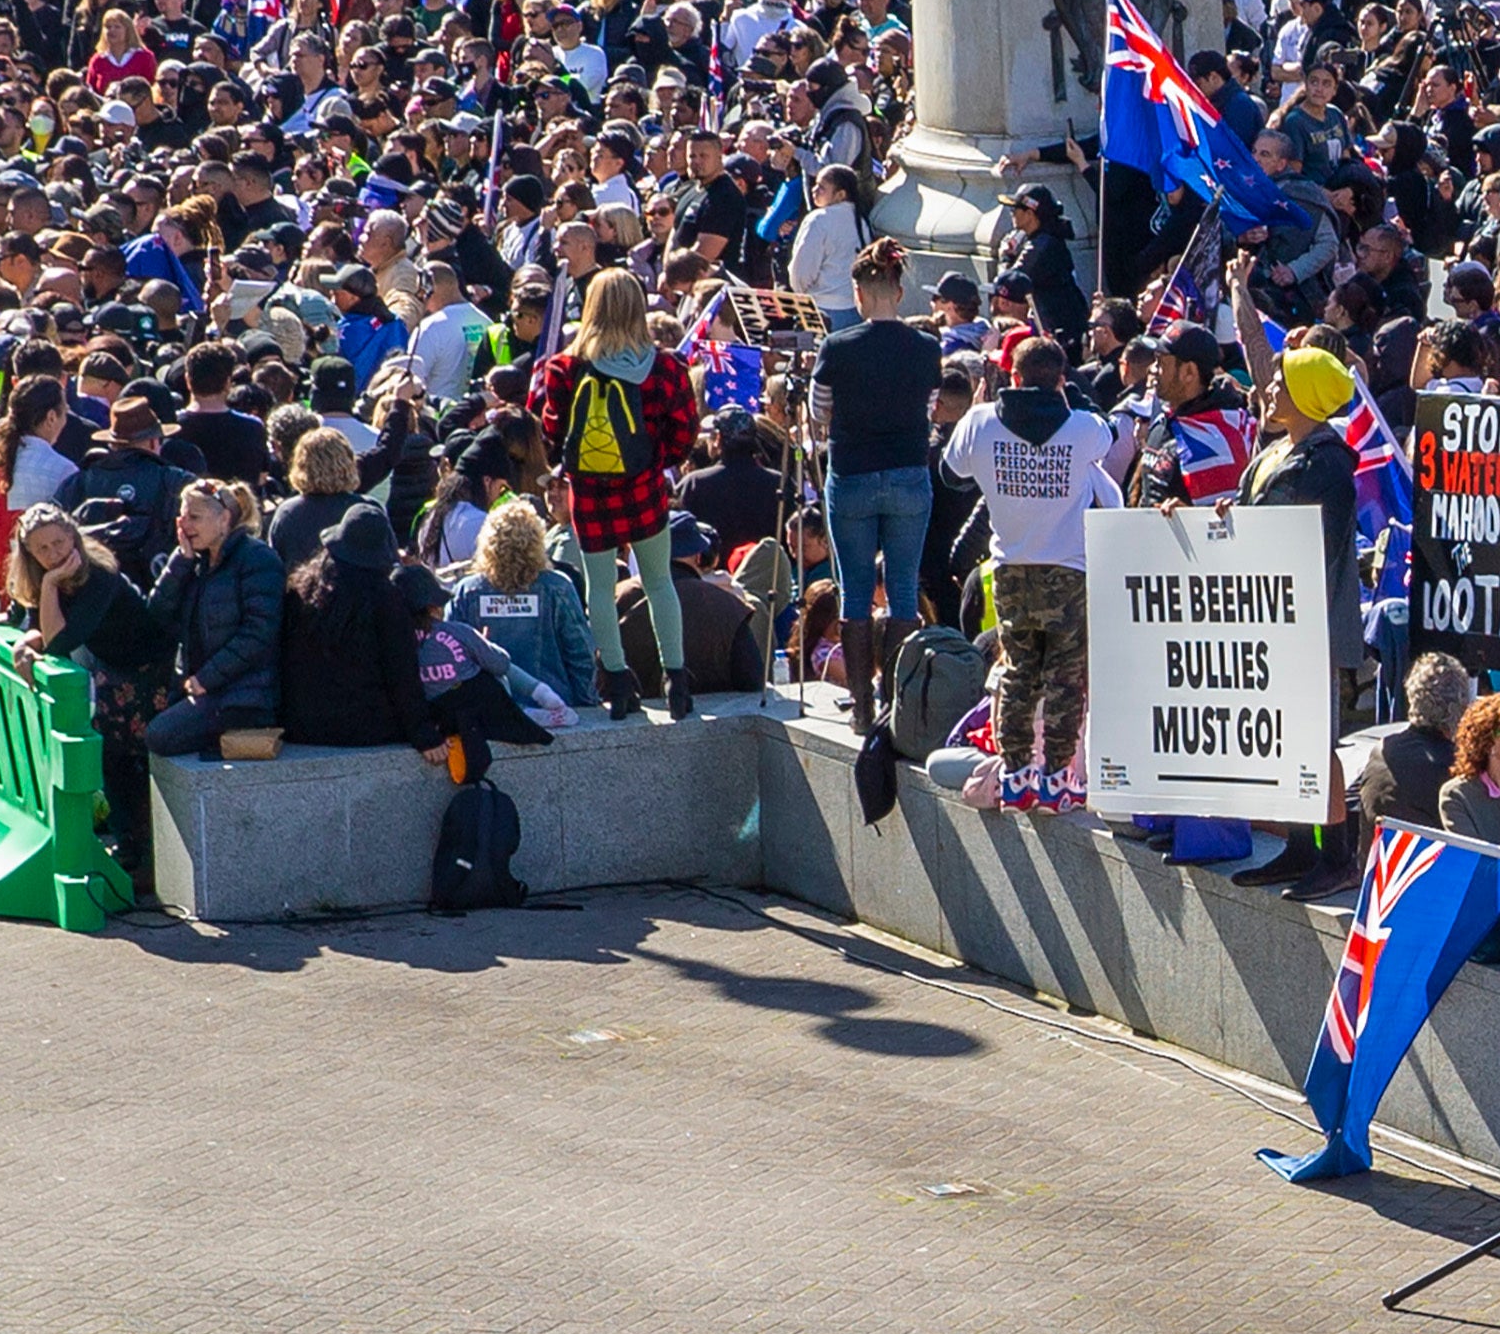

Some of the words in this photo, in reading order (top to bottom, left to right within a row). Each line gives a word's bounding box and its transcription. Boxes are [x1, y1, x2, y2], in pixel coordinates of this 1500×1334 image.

[994, 455, 1072, 471] FREEDOMSNZ
[1419, 430, 1437, 491] 3
[995, 469, 1070, 485] FREEDOMSNZ
[997, 482, 1070, 499] FREEDOMSNZ
[486, 606, 499, 614] WE
[507, 605, 533, 614] STAND
[1125, 575, 1183, 623] THE
[1188, 575, 1296, 624] BEEHIVE
[435, 630, 467, 663] GIRLS
[419, 663, 457, 683] LUB
[1166, 640, 1270, 691] BULLIES
[1152, 706, 1231, 756] MUST
[1236, 707, 1282, 759] GO!
